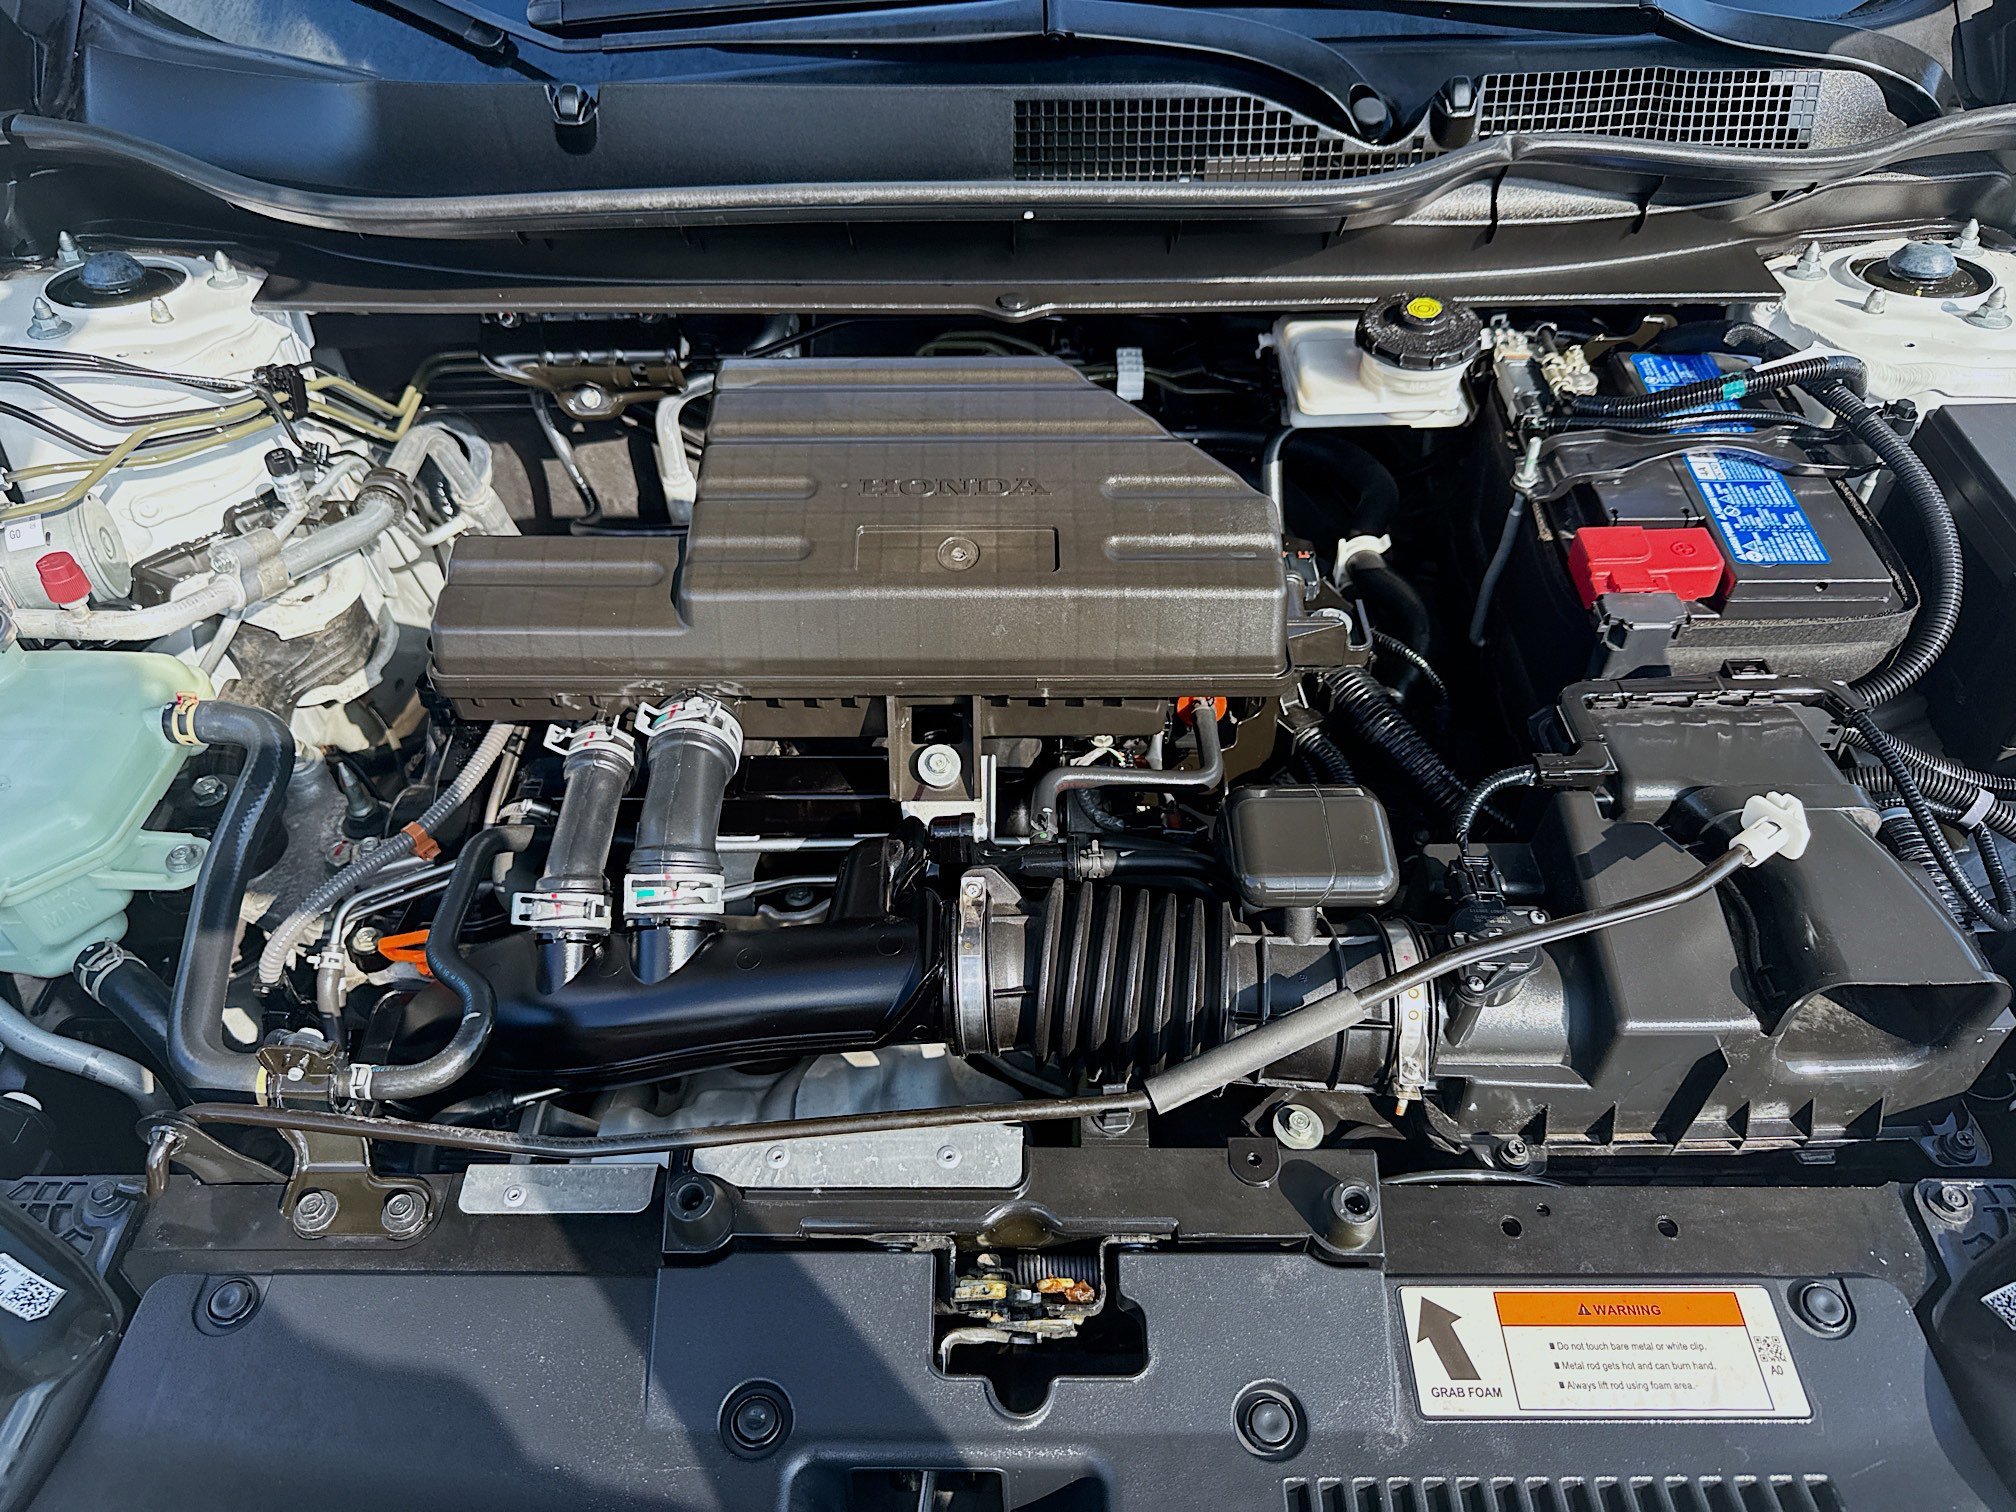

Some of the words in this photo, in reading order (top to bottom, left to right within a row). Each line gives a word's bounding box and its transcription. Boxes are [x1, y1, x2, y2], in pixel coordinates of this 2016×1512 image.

[859, 477, 1053, 498] HONDA
[41, 896, 95, 931] MIN
[1592, 1304, 1662, 1316] WARNING
[1556, 1341, 1569, 1351] Do
[1571, 1342, 1585, 1351] not
[1585, 1341, 1609, 1351] touch
[1609, 1341, 1630, 1351] bare
[1631, 1342, 1654, 1351] metal
[1655, 1343, 1664, 1351] or
[1666, 1341, 1688, 1351] white
[1689, 1341, 1708, 1352] clip.
[1561, 1361, 1585, 1370] Metal
[1586, 1361, 1601, 1370] rod
[1602, 1361, 1620, 1372] gets
[1621, 1361, 1636, 1370] hot
[1637, 1361, 1654, 1370] and
[1671, 1361, 1692, 1370] burn
[1692, 1361, 1717, 1370] hand.
[1567, 1380, 1597, 1391] Always
[1597, 1380, 1609, 1390] lift
[1610, 1380, 1625, 1390] rod
[1626, 1381, 1650, 1392] using
[1650, 1380, 1672, 1390] foam
[1673, 1382, 1696, 1390] area.
[1431, 1387, 1466, 1398] GRAB
[1468, 1387, 1503, 1398] FOAM
